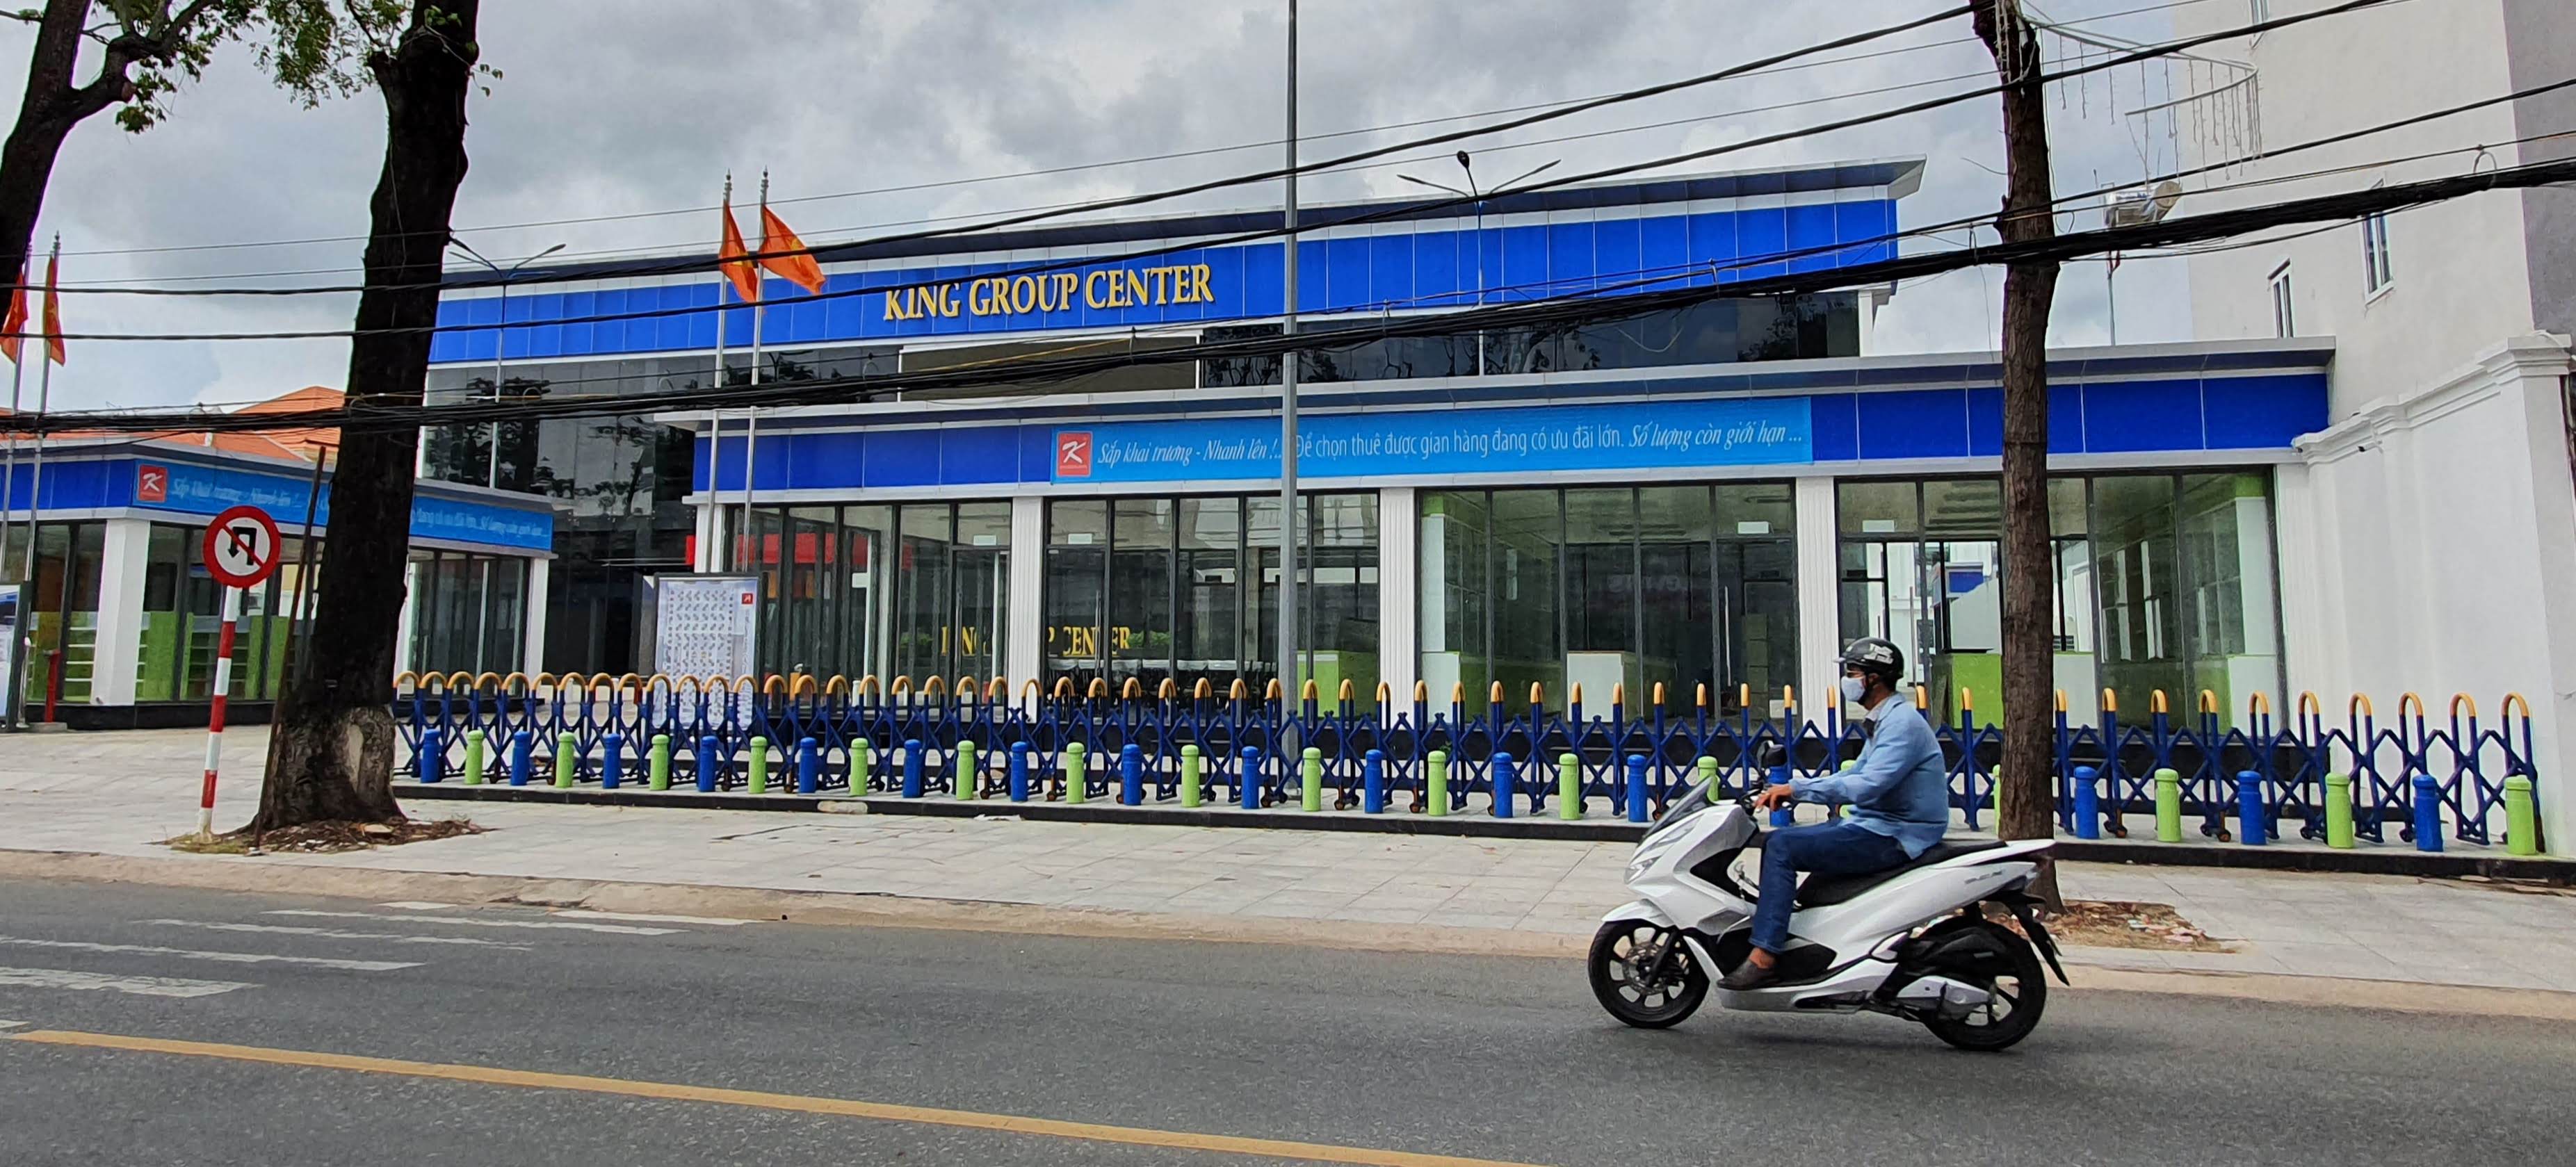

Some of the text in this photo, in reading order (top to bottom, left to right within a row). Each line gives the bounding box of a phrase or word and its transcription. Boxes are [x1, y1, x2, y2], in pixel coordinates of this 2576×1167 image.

[883, 263, 1215, 321] KING GROUP CENTER
[1097, 439, 1120, 468] Sắp
[1123, 442, 1151, 462] khai
[1151, 445, 1191, 466] trương
[1203, 437, 1245, 461] Nhanh
[1247, 436, 1266, 460] lên
[1315, 434, 1347, 461] chọn
[1351, 432, 1381, 457] thuê
[1384, 431, 1417, 459] được
[1420, 431, 1449, 459] gian
[1453, 429, 1488, 458] hàng
[1492, 427, 1527, 457] đang
[1531, 426, 1547, 451] có
[1551, 429, 1568, 450] ưu
[1573, 424, 1594, 449] đãi
[1598, 423, 1624, 449] lớn.
[1629, 421, 1653, 448] Số
[1651, 424, 1692, 452] lượng
[1695, 423, 1722, 446] còn
[1724, 421, 1757, 450] giới
[1757, 420, 1786, 447] hạn
